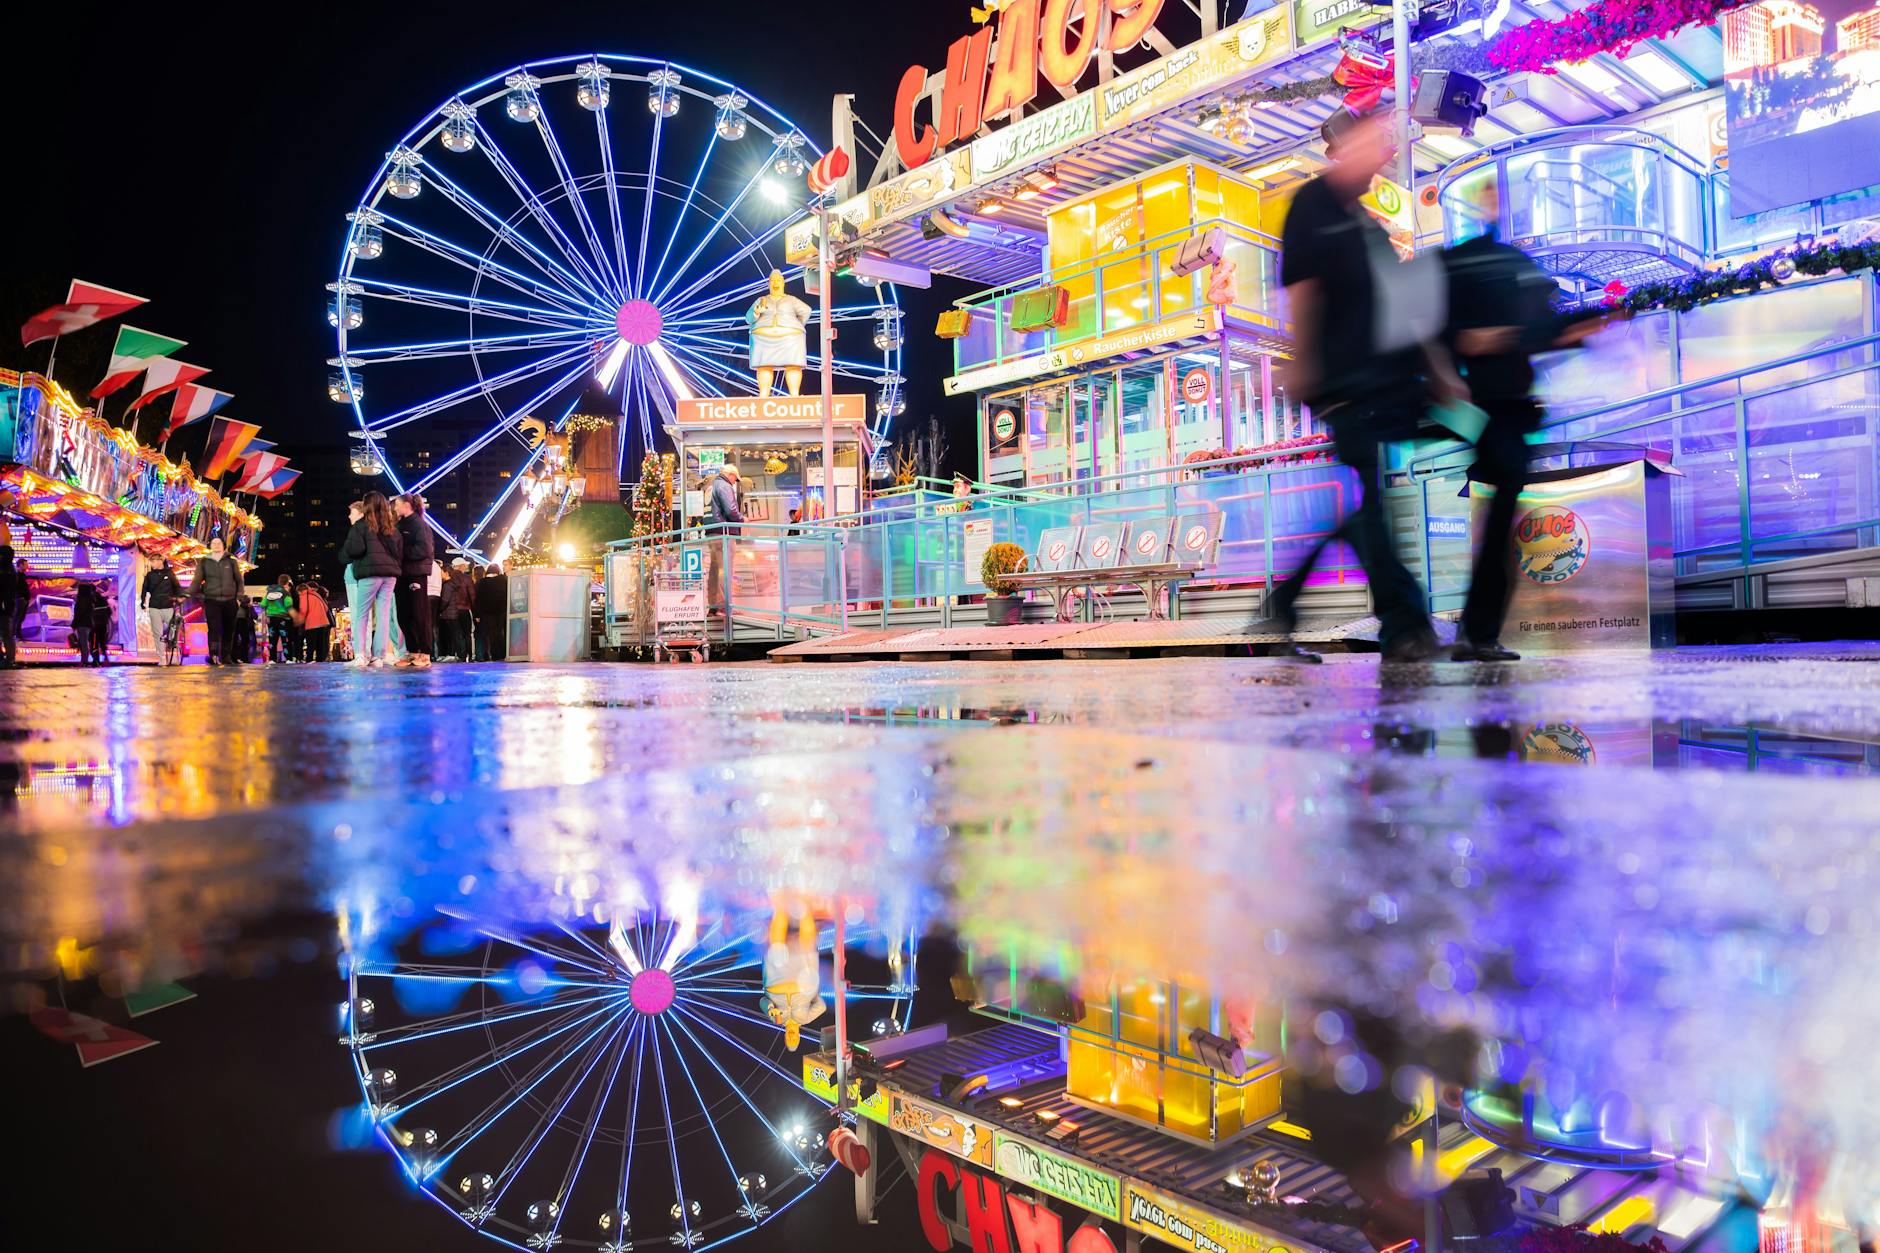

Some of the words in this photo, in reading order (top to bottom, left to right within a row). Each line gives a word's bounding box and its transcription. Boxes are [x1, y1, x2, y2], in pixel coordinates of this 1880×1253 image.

[1314, 0, 1364, 27] HABE
[1104, 82, 1139, 120] Never
[1141, 69, 1166, 96] com
[1167, 51, 1199, 79] back
[1023, 117, 1059, 156] GEIZ
[1061, 103, 1091, 139] FLY
[1189, 377, 1205, 386] VOLL
[696, 402, 757, 419] Ticket
[763, 401, 845, 418] Countr
[998, 416, 1011, 425] VOLL
[1429, 521, 1466, 534] AUSGANG
[687, 553, 699, 580] P
[1519, 622, 1532, 632] Für
[1534, 622, 1556, 632] einen
[1558, 619, 1598, 631] sauberen
[1600, 616, 1640, 629] Festplatz
